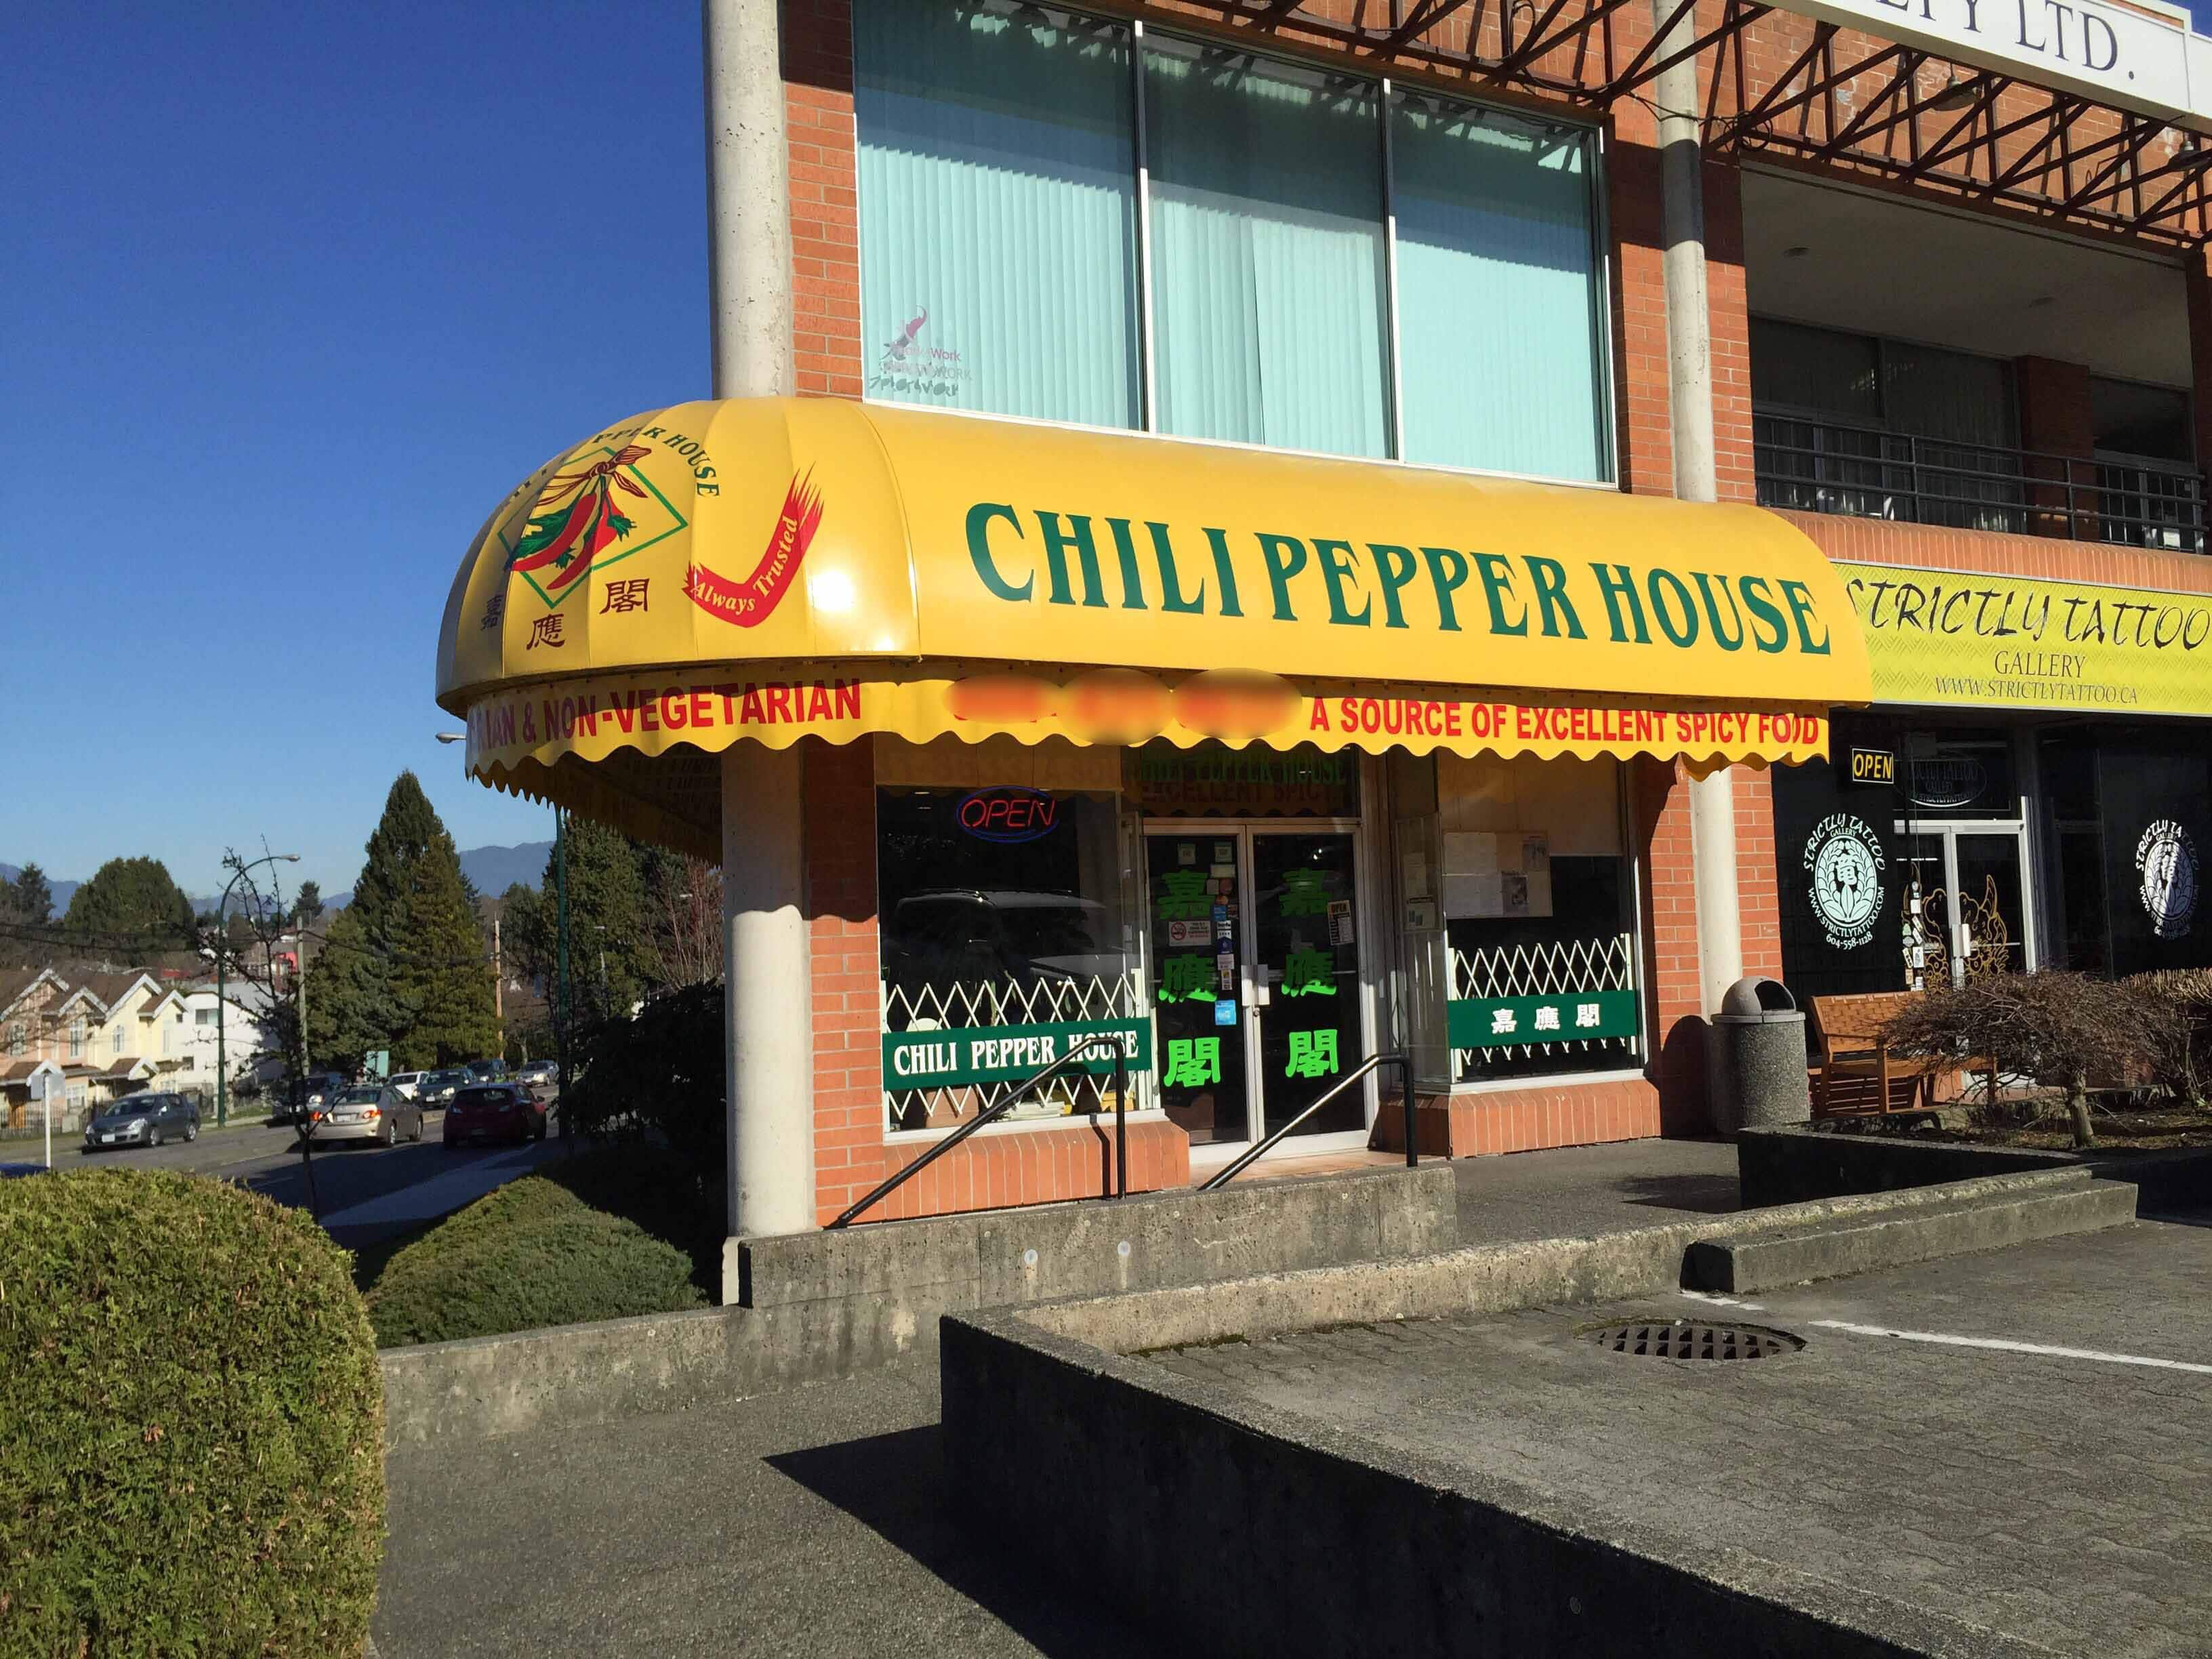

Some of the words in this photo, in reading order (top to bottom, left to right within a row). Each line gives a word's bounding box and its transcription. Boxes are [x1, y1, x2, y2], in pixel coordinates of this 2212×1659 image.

[2015, 0, 2135, 80] LTD.
[662, 433, 720, 498] HOUSE
[690, 582, 756, 615] Always
[752, 515, 798, 598] Trusted
[966, 502, 1244, 617] CHILI
[1254, 532, 1589, 640] PEPPER
[1588, 562, 1831, 655] HOUSE
[2062, 596, 2211, 651] TATTOO
[1994, 650, 2087, 678] GALLERY
[523, 701, 537, 743] &
[543, 678, 861, 742] NON-VEGETARIAN
[1935, 677, 2138, 703] WWW.STRICTLYTATTOO.CA
[1310, 697, 1330, 731] A
[1340, 697, 1461, 736] SOURCE
[1471, 702, 1507, 738] OF
[1517, 706, 1667, 742] EXCELLENT
[1676, 712, 1750, 743] SPICY
[1853, 752, 1892, 780] OPEN
[962, 798, 1056, 828] OPEN
[1830, 827, 1857, 837] GALLERY
[1803, 813, 1846, 872] STRICTLY
[1849, 815, 1885, 871] TATTOO
[2135, 819, 2169, 872] STRICTLY
[1808, 886, 1885, 937] WWW.STRICTLYTATTOO.COM
[1826, 931, 1873, 950] 604-558-1128
[894, 1042, 958, 1076] CHILI
[970, 1036, 1056, 1070] PEPPER
